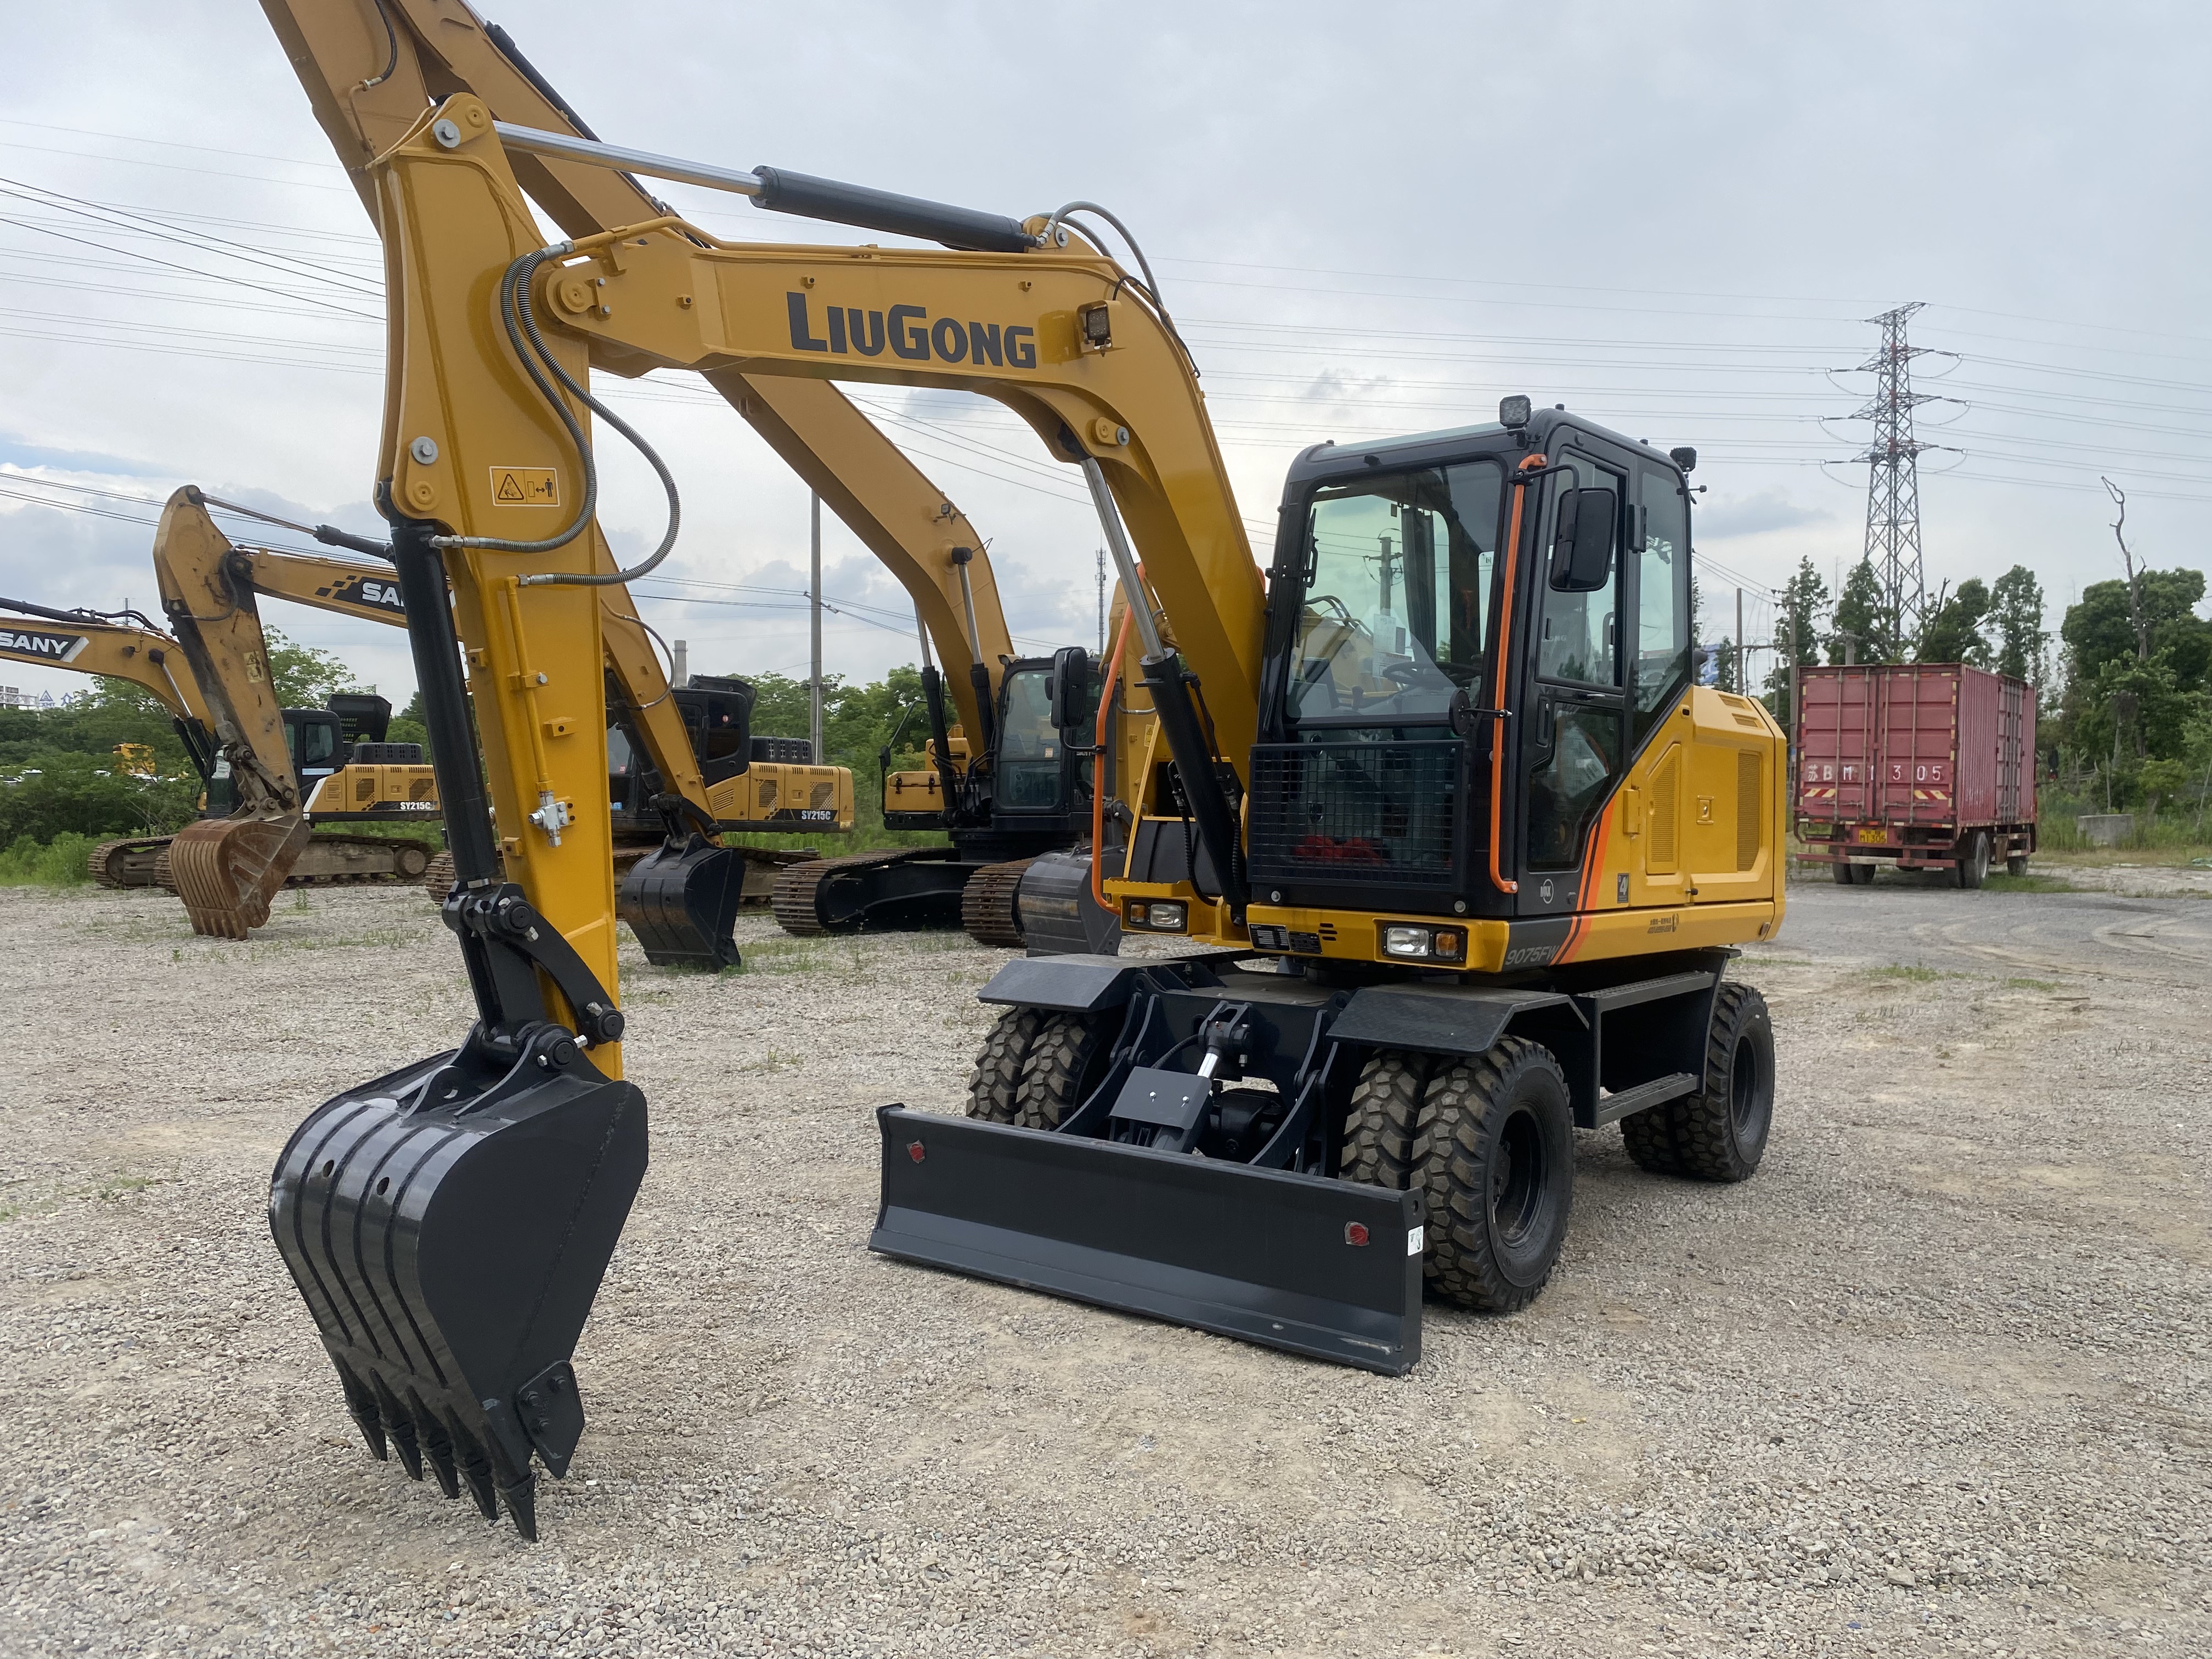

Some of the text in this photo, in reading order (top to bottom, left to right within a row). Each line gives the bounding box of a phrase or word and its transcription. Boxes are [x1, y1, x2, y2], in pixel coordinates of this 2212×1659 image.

[0, 632, 69, 654] SANY
[400, 802, 431, 810] SY215C
[802, 810, 831, 820] SY215C
[1505, 945, 1560, 966] 9075FW
